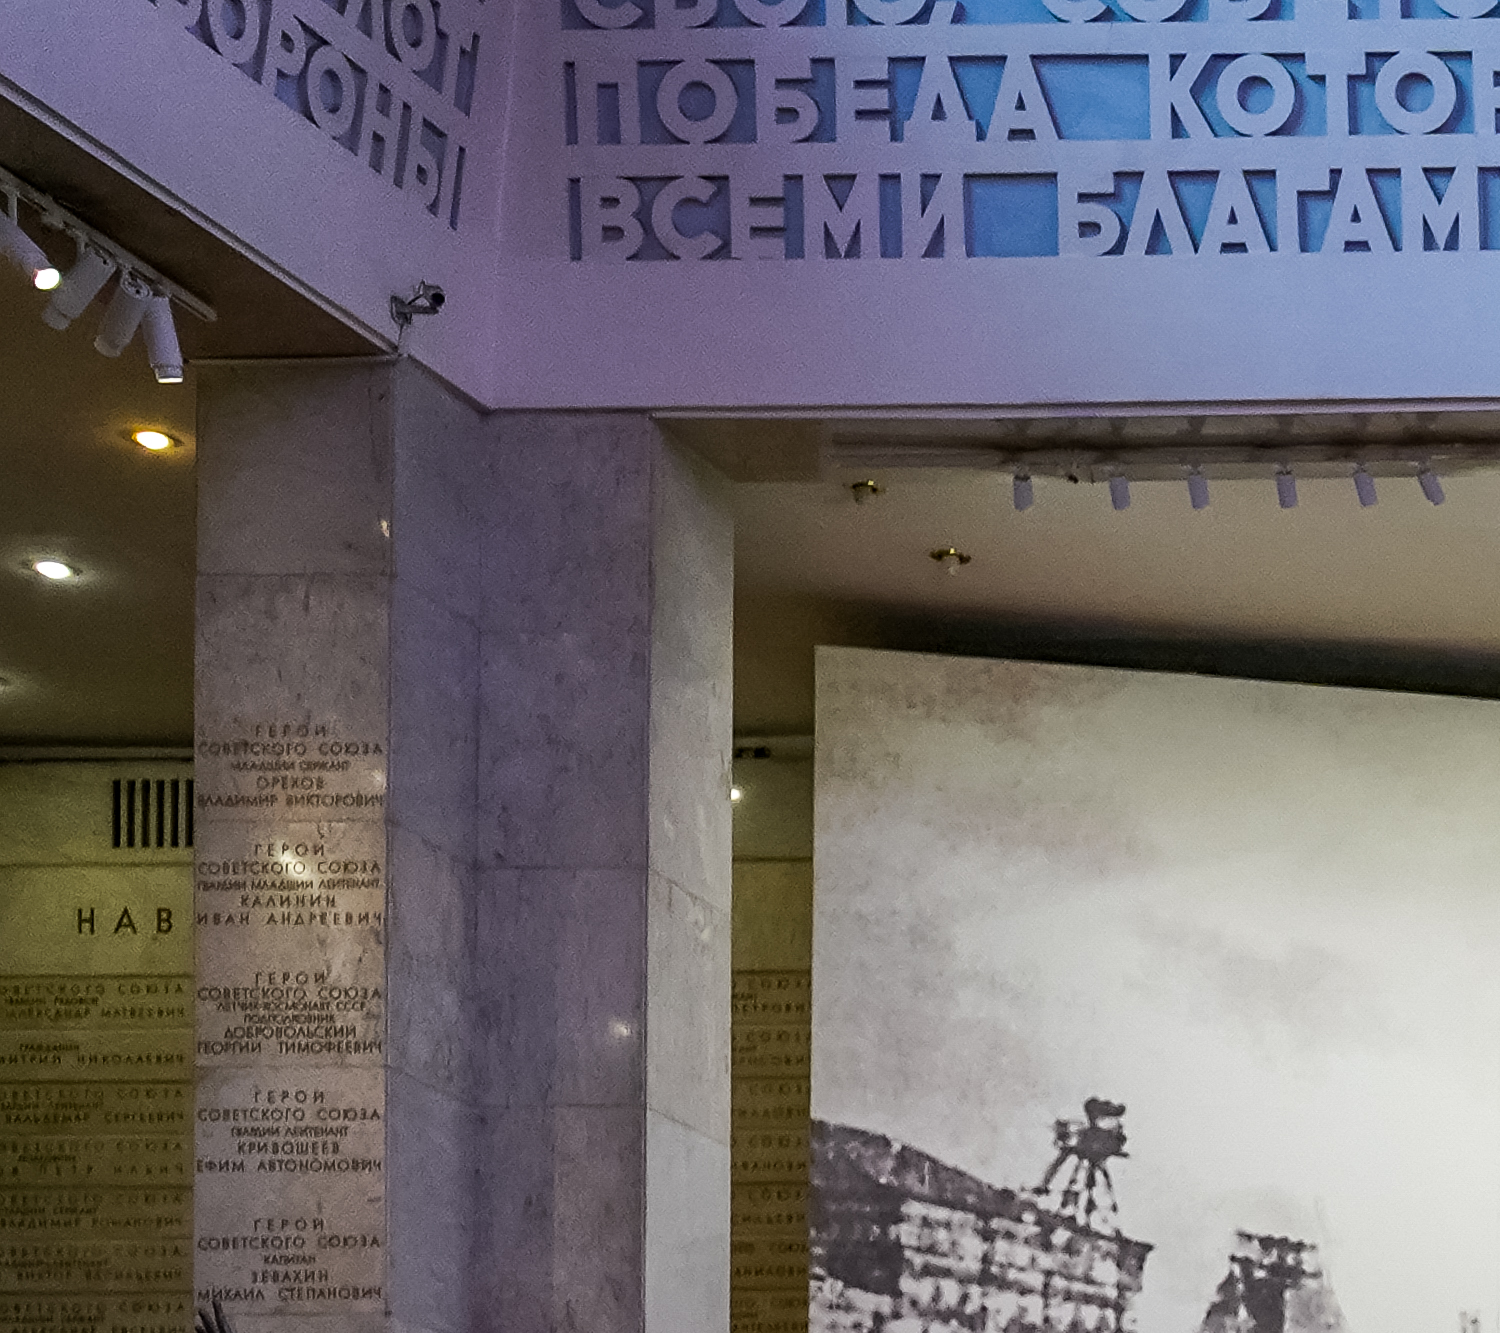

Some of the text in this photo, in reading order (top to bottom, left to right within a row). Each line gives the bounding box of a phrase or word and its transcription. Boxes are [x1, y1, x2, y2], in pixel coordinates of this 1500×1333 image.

[575, 55, 1062, 144] ПОБЕДА
[579, 174, 966, 260] ВСЕМИ
[198, 742, 382, 757] СОВЕТСКОГО СОЮЗА
[198, 861, 381, 876] СОВЕТСКОГО СОЮЗА
[198, 987, 382, 1001] СОВЕТСКОГО СОЮЗА
[198, 1108, 381, 1122] СОВЕТСКОГО СОЮЗА
[198, 1236, 381, 1251] СОВЕТСКОГО СОЮЗА
